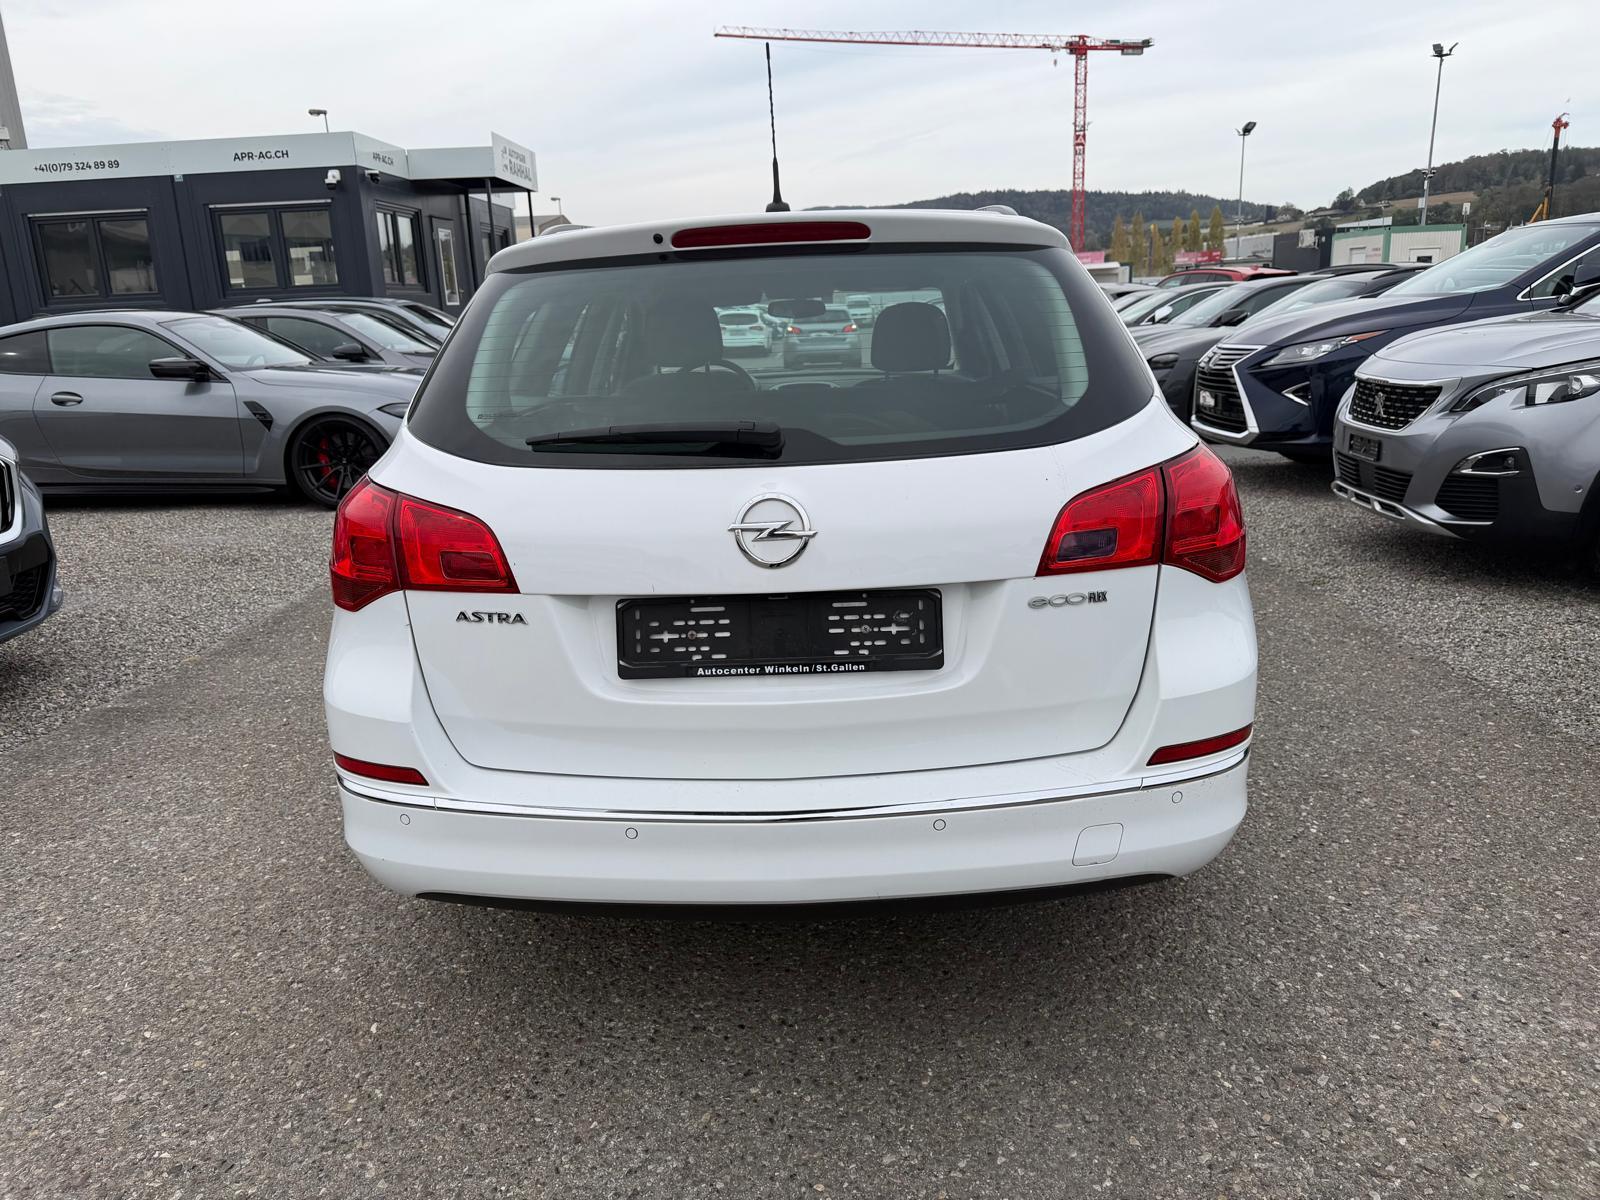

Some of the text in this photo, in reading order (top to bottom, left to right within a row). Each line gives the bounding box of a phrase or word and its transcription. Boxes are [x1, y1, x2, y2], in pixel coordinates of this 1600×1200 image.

[233, 149, 289, 162] APR-AG.CH
[33, 160, 120, 173] +41(0)79 324 89 89
[455, 611, 529, 625] ASTRA
[697, 666, 761, 676] Autocenter
